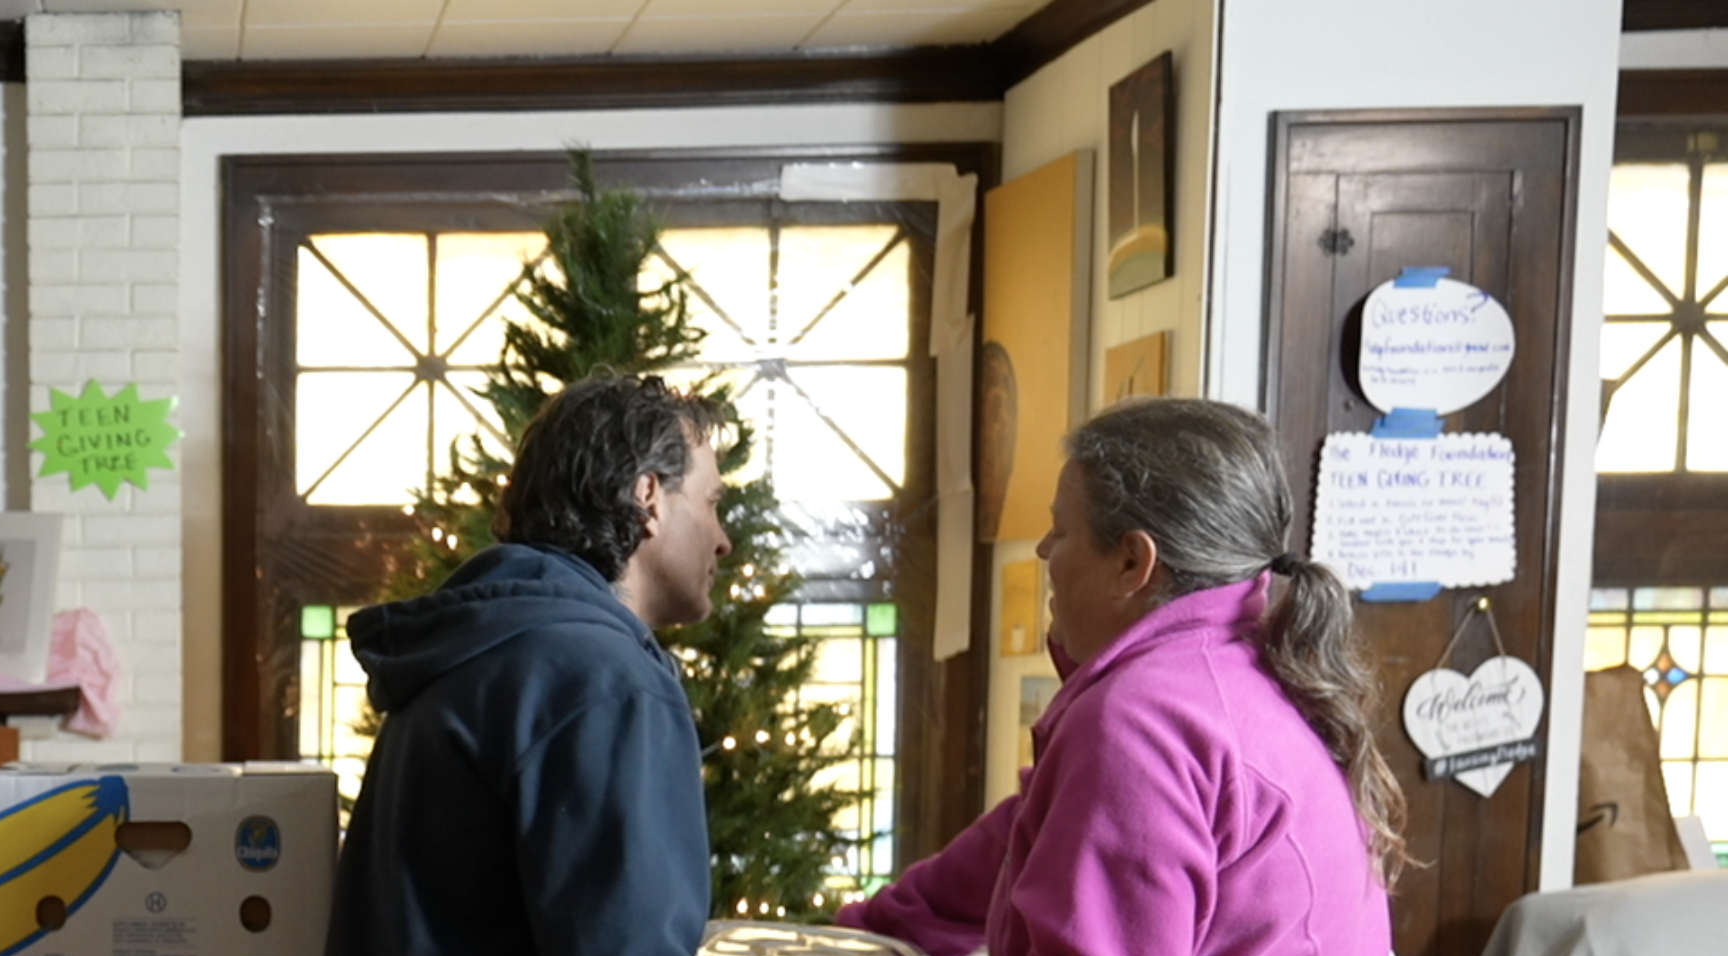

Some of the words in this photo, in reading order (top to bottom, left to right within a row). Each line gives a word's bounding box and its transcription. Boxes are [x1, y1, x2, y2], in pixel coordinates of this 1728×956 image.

[1371, 290, 1491, 329] Questions?
[57, 404, 130, 428] TEEN
[57, 428, 152, 458] GIVING
[82, 452, 138, 475] TREE
[1331, 471, 1368, 489] TEEN
[1377, 469, 1431, 489] GIVING
[1439, 471, 1488, 489] TREE
[1416, 677, 1524, 723] Welcome
